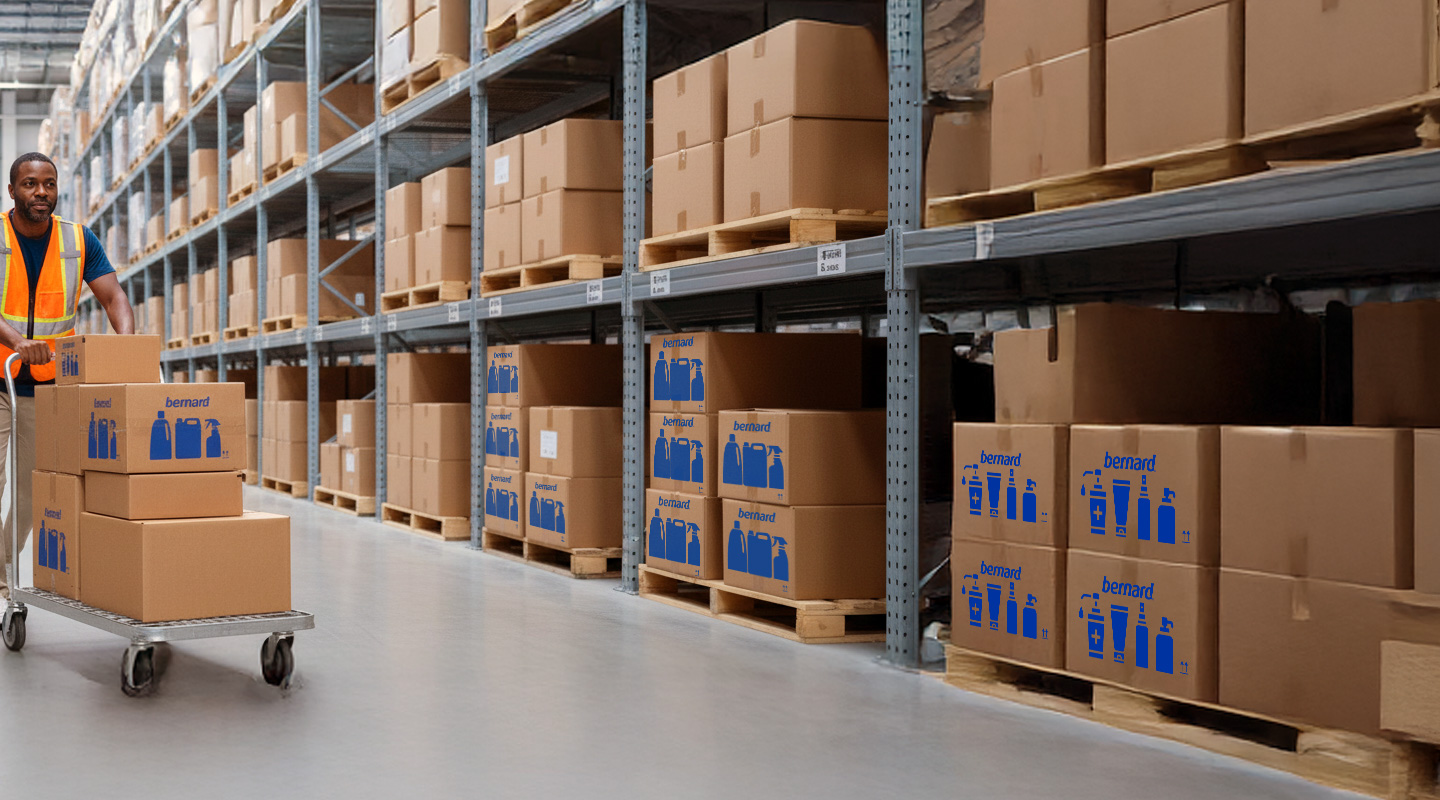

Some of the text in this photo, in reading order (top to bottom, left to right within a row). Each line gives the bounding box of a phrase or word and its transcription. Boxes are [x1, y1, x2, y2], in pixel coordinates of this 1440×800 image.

[663, 336, 694, 348] bernard
[166, 396, 210, 408] bernard
[663, 416, 694, 428] bernard
[734, 421, 772, 433] bernard
[980, 450, 1021, 467] bernard
[1104, 452, 1156, 472] bernard
[534, 482, 557, 492] bernard
[658, 496, 691, 510] bernard
[738, 508, 777, 522] bernard
[980, 561, 1021, 580] bernard
[1102, 576, 1154, 600] bernard
